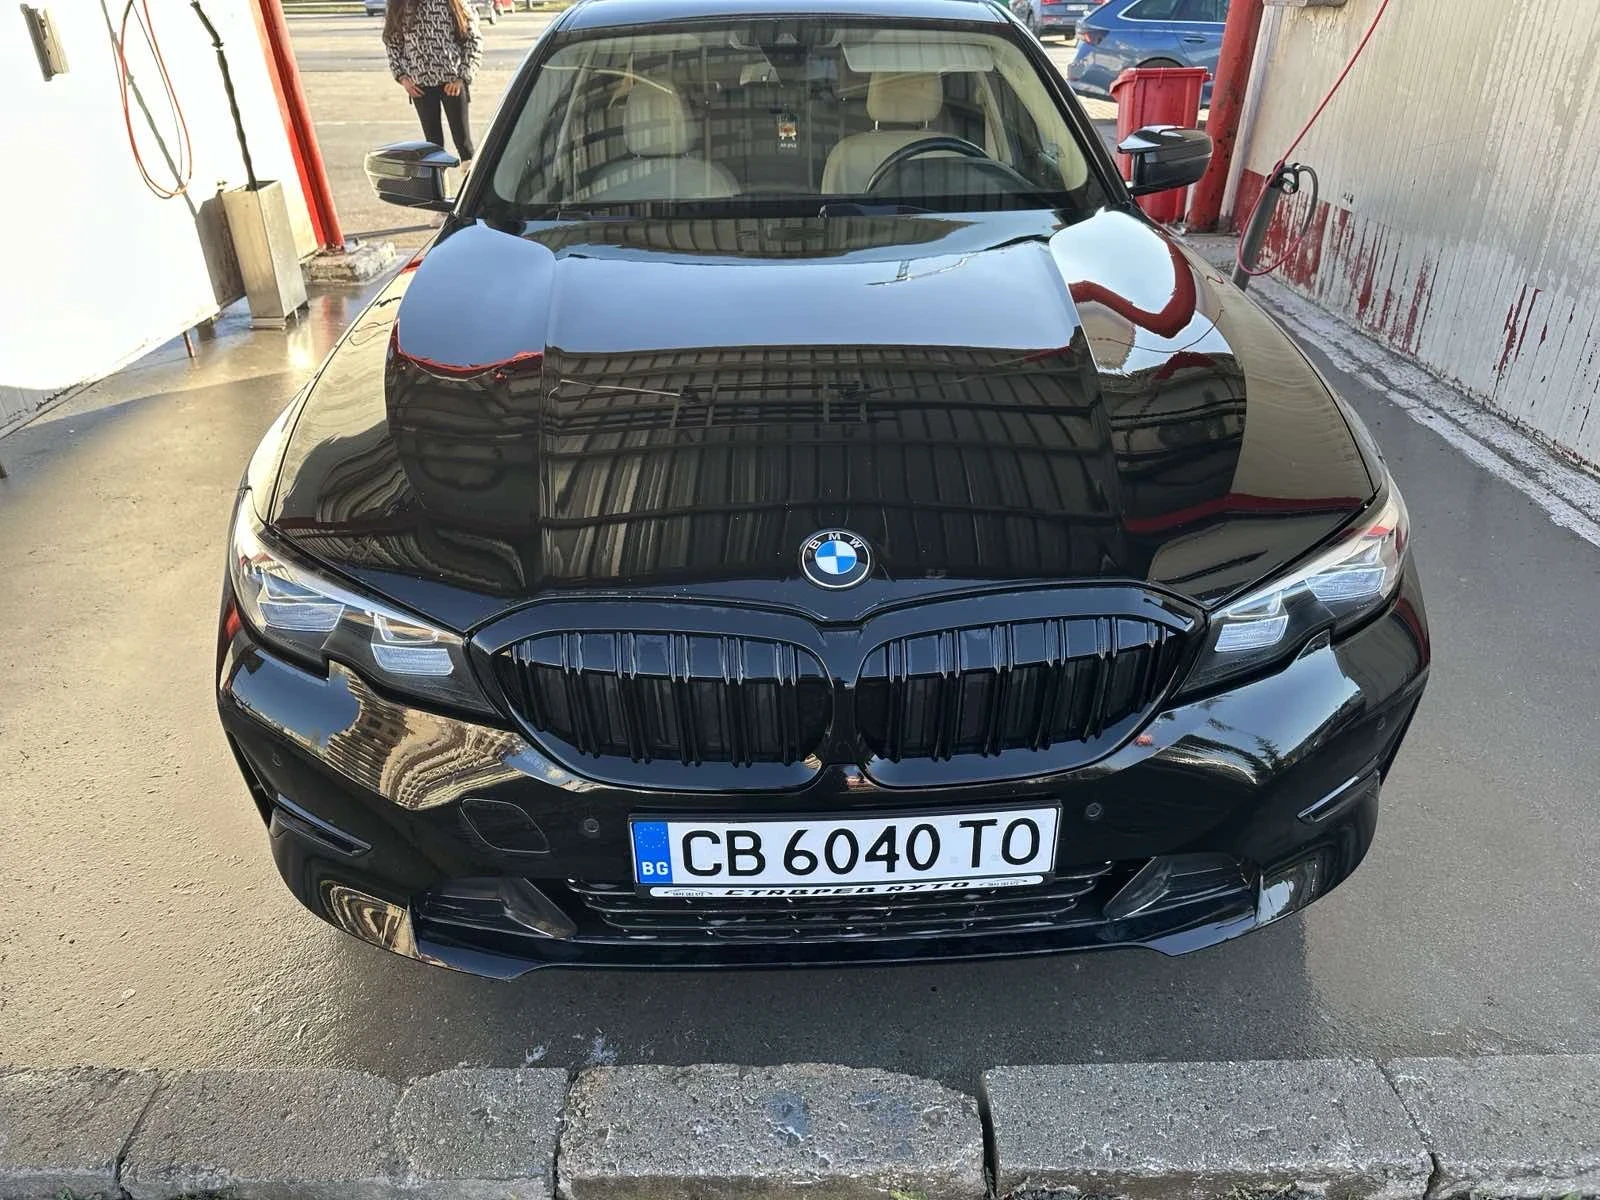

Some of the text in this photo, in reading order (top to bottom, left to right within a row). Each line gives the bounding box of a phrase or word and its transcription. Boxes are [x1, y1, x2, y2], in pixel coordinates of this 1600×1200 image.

[809, 532, 862, 549] BMW
[682, 817, 1041, 876] CB 6040 TO
[641, 861, 669, 876] BG
